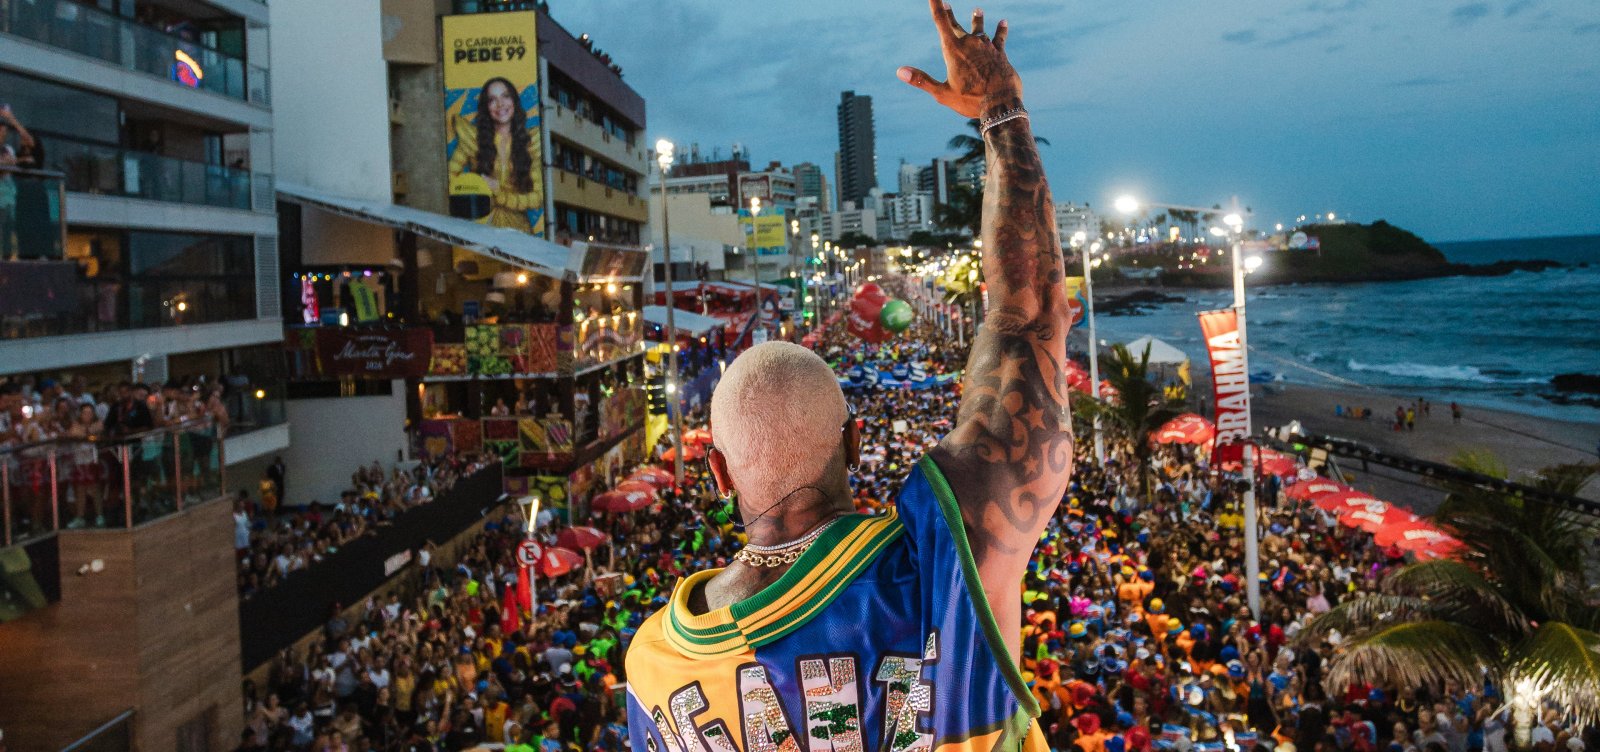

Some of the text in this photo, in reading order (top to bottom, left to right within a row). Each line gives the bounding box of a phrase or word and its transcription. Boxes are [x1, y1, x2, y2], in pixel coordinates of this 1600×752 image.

[454, 35, 526, 48] O CARNAVAL
[454, 46, 526, 64] PEDE 99
[1208, 330, 1247, 447] BRAHMA
